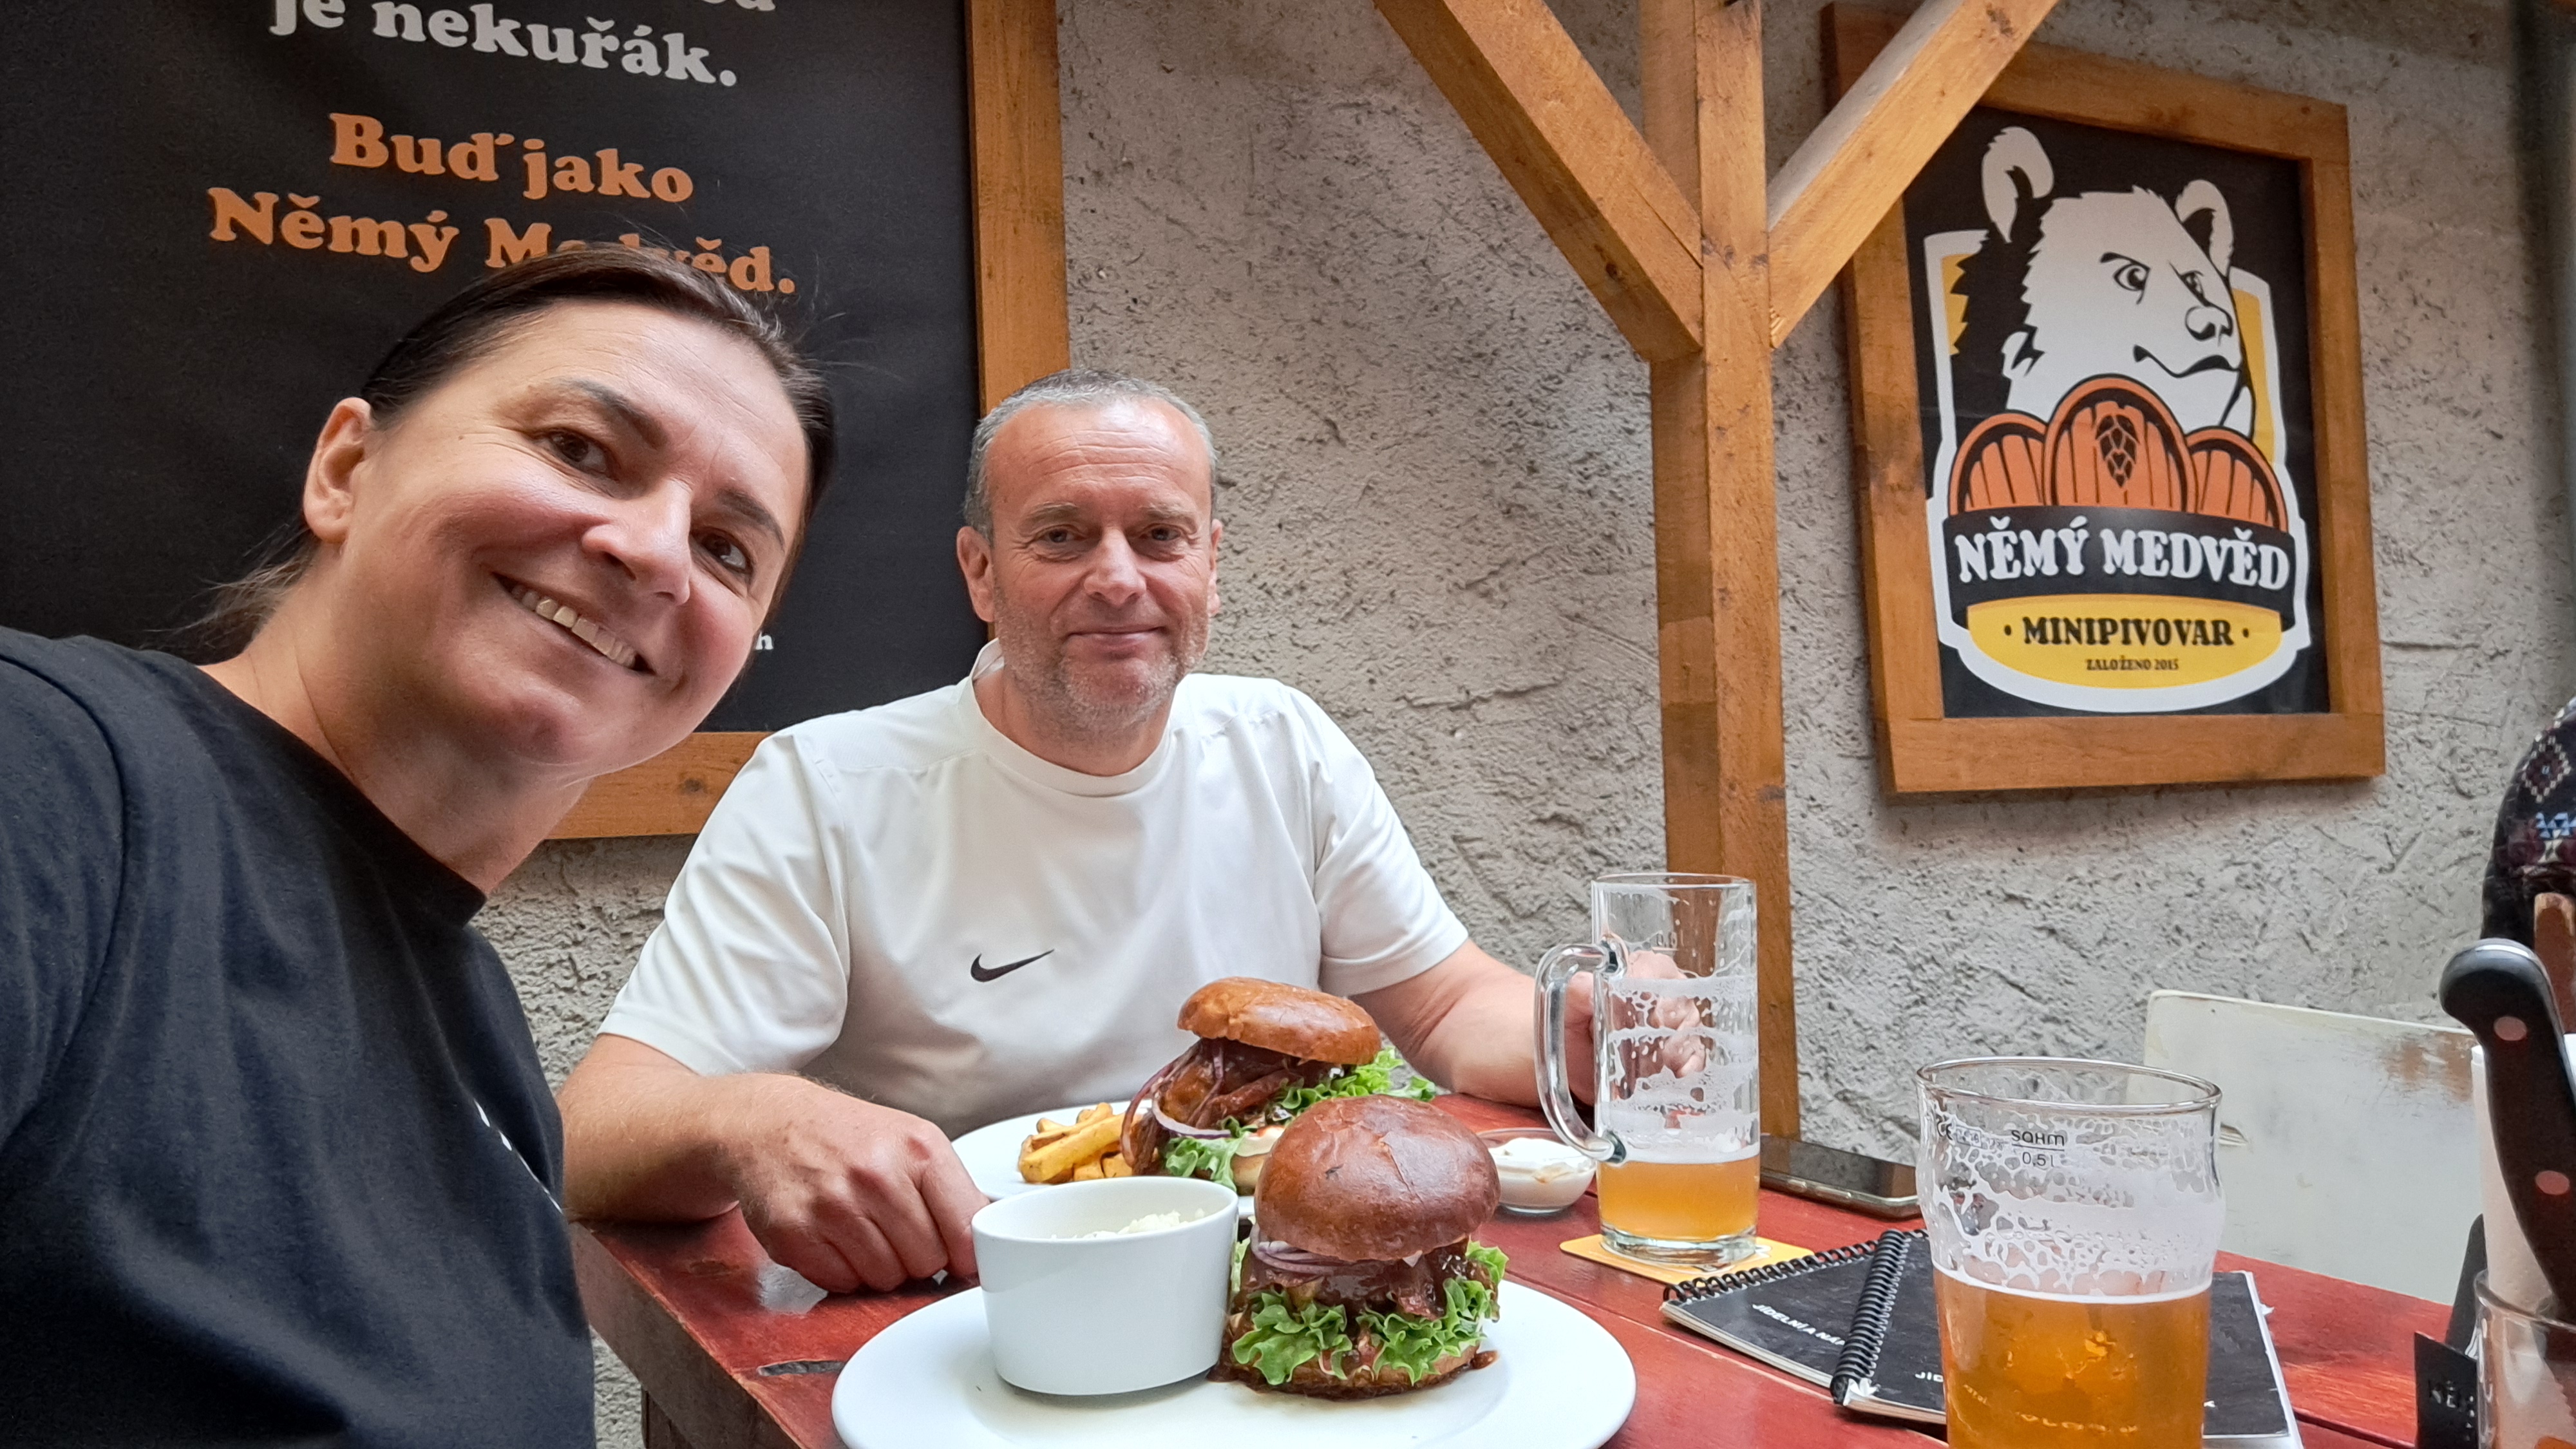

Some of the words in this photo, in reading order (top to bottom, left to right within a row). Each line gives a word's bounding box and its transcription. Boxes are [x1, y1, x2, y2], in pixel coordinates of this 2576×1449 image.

[269, 0, 346, 35] je
[372, 0, 737, 87] nekuřák.
[329, 113, 514, 182] Buď
[523, 139, 693, 202] jako
[207, 187, 459, 273] Němý
[484, 218, 796, 294] Měd.
[1954, 516, 2090, 583] NĚMÝ
[2099, 527, 2291, 590] MEDVĚD
[2022, 616, 2235, 646] MINIPIVOVAR
[2086, 654, 2152, 671] ZALOŽENO
[2154, 658, 2179, 670] 2015
